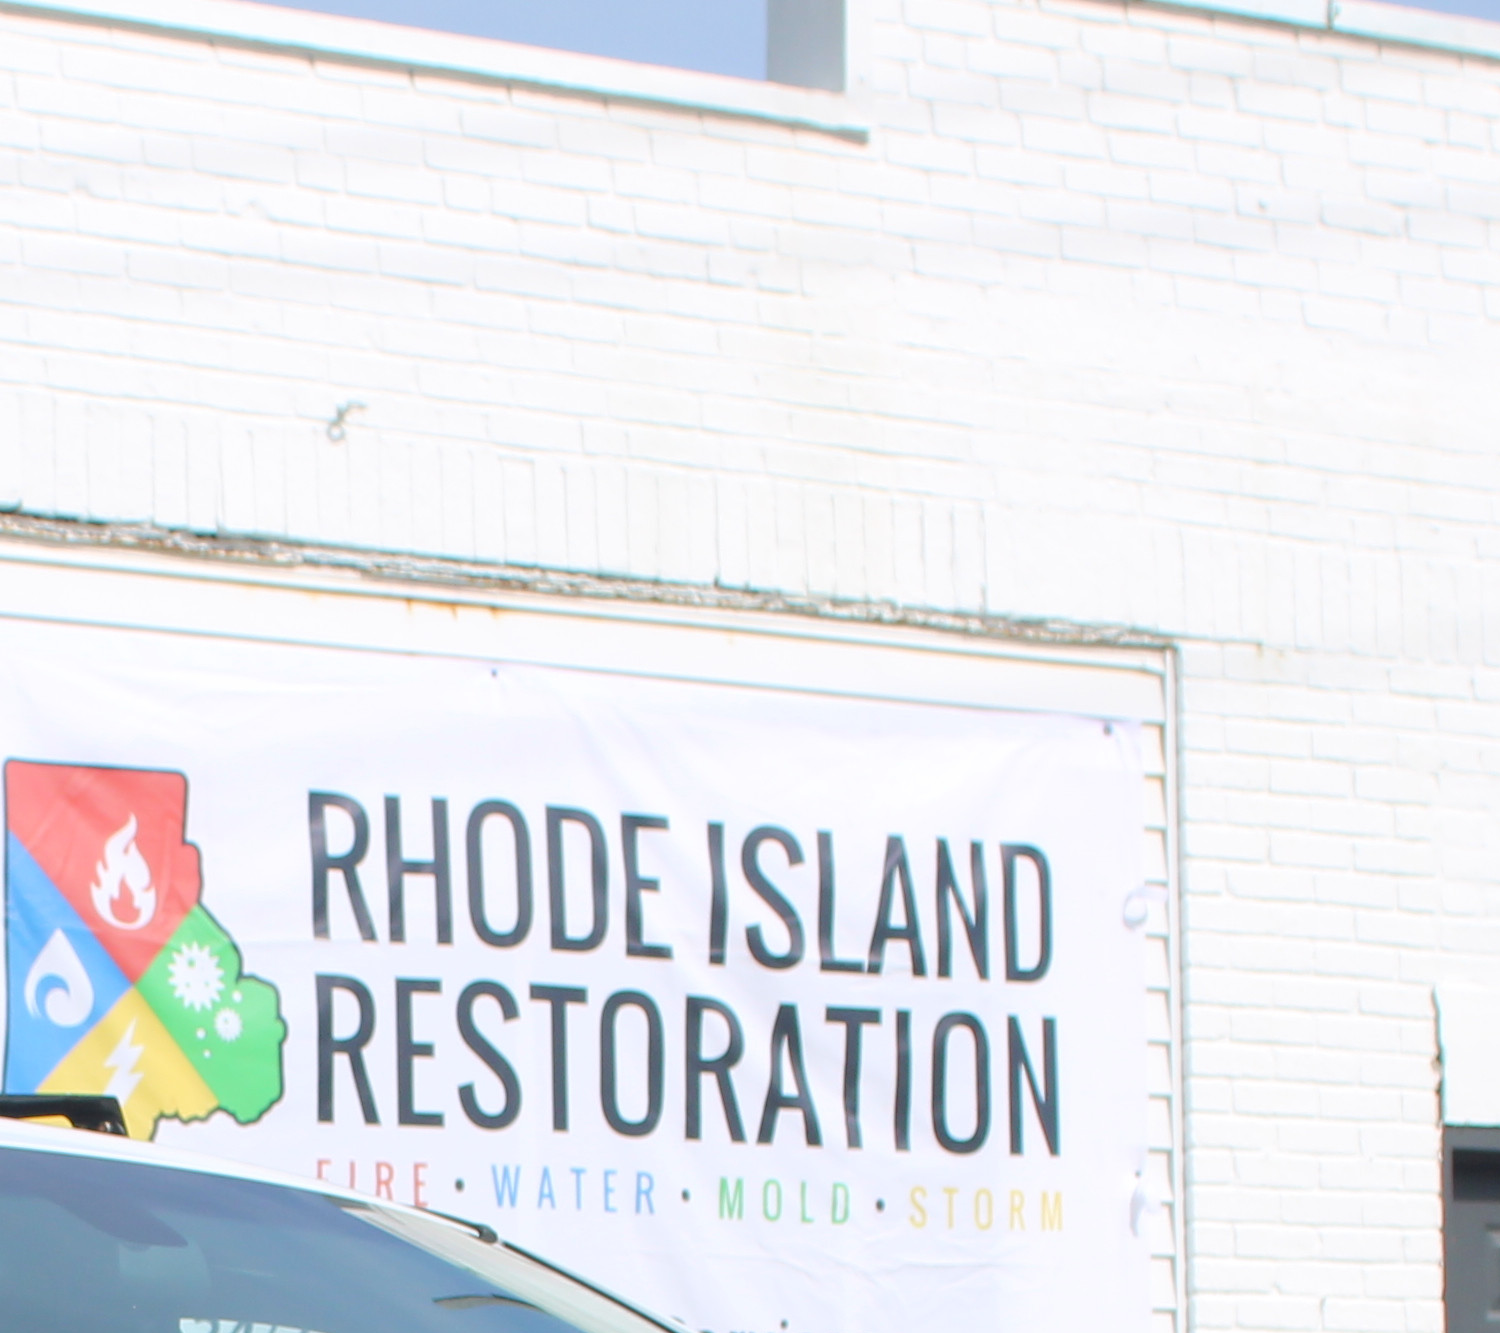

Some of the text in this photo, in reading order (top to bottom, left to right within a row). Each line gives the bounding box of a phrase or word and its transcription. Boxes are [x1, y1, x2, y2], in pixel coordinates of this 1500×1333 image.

[307, 788, 1055, 984] RHODE ISLAND
[313, 971, 1061, 1157] RESTORATION
[490, 1163, 657, 1216] WATER
[717, 1175, 850, 1225] MOLD
[908, 1184, 1065, 1233] STORM
